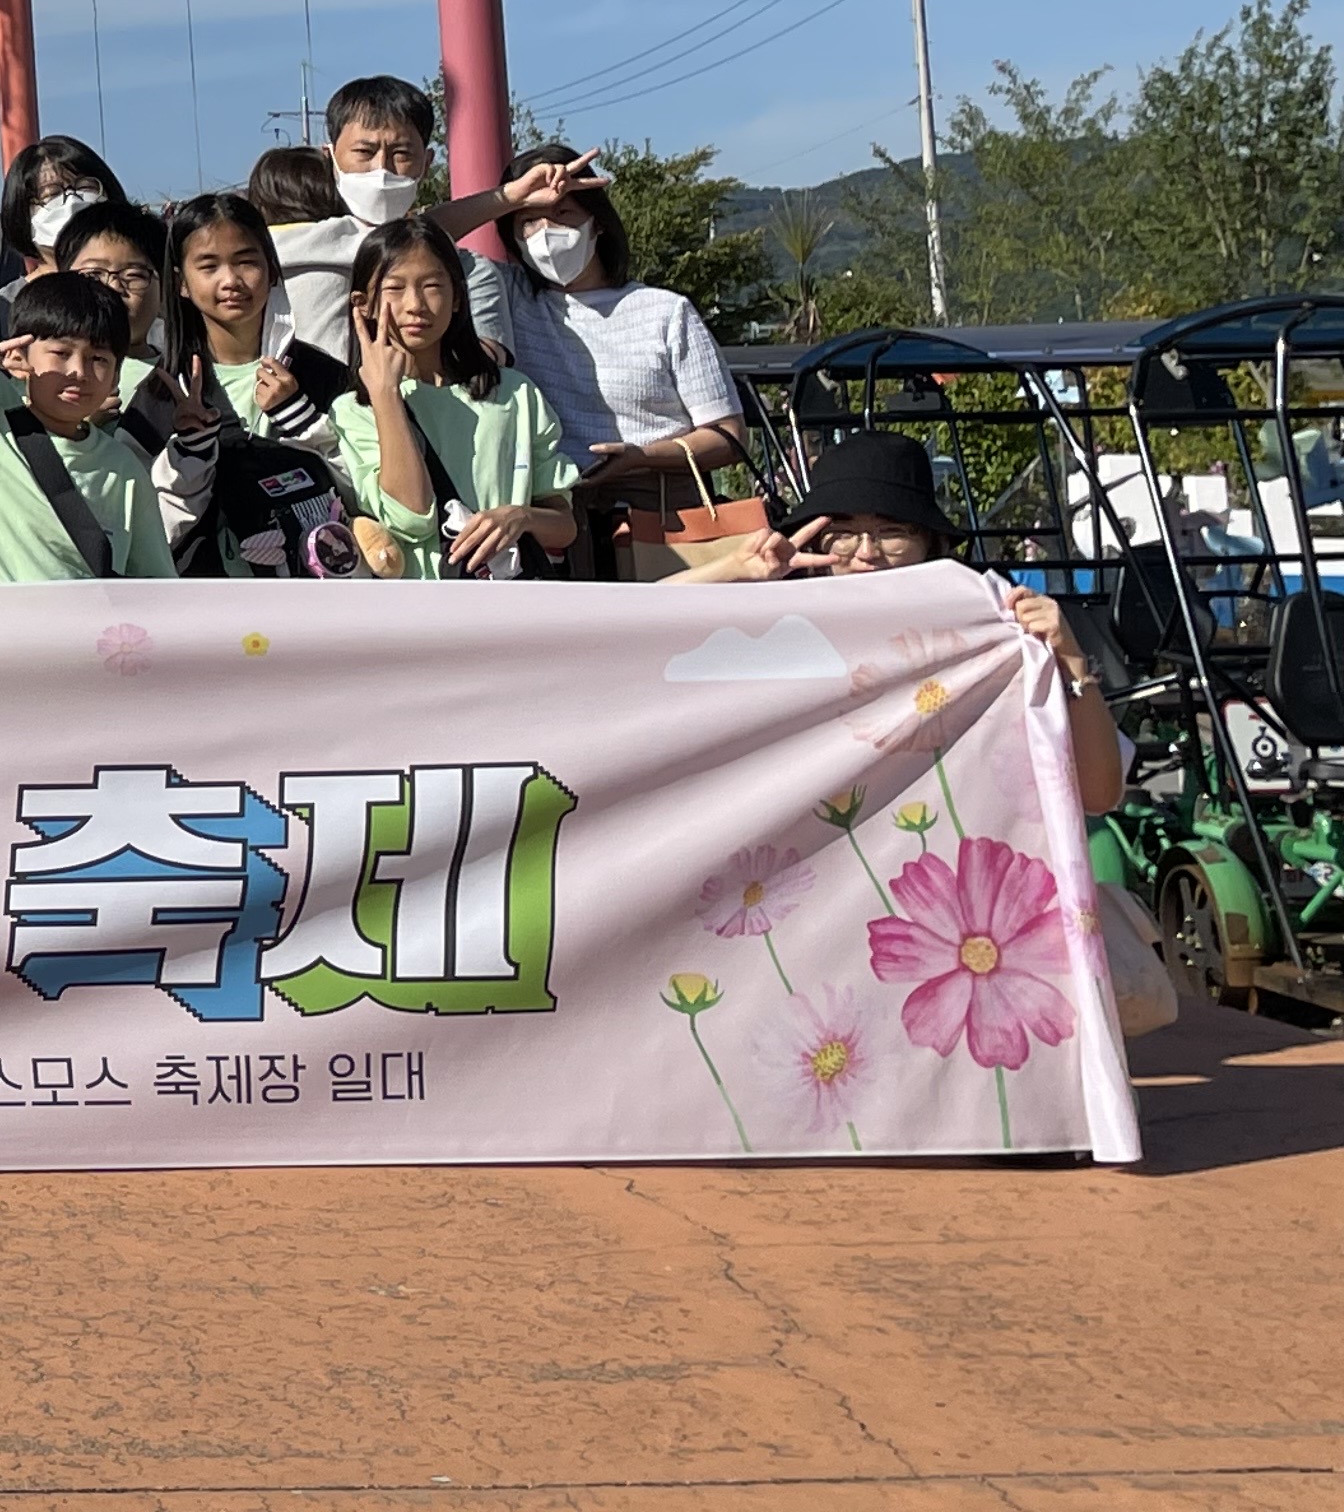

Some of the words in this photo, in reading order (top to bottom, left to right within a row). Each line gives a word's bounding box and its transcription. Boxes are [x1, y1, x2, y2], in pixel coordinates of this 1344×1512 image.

[2, 762, 579, 1022] 축제
[153, 1052, 306, 1106] 축제장
[326, 1050, 426, 1102] 일대
